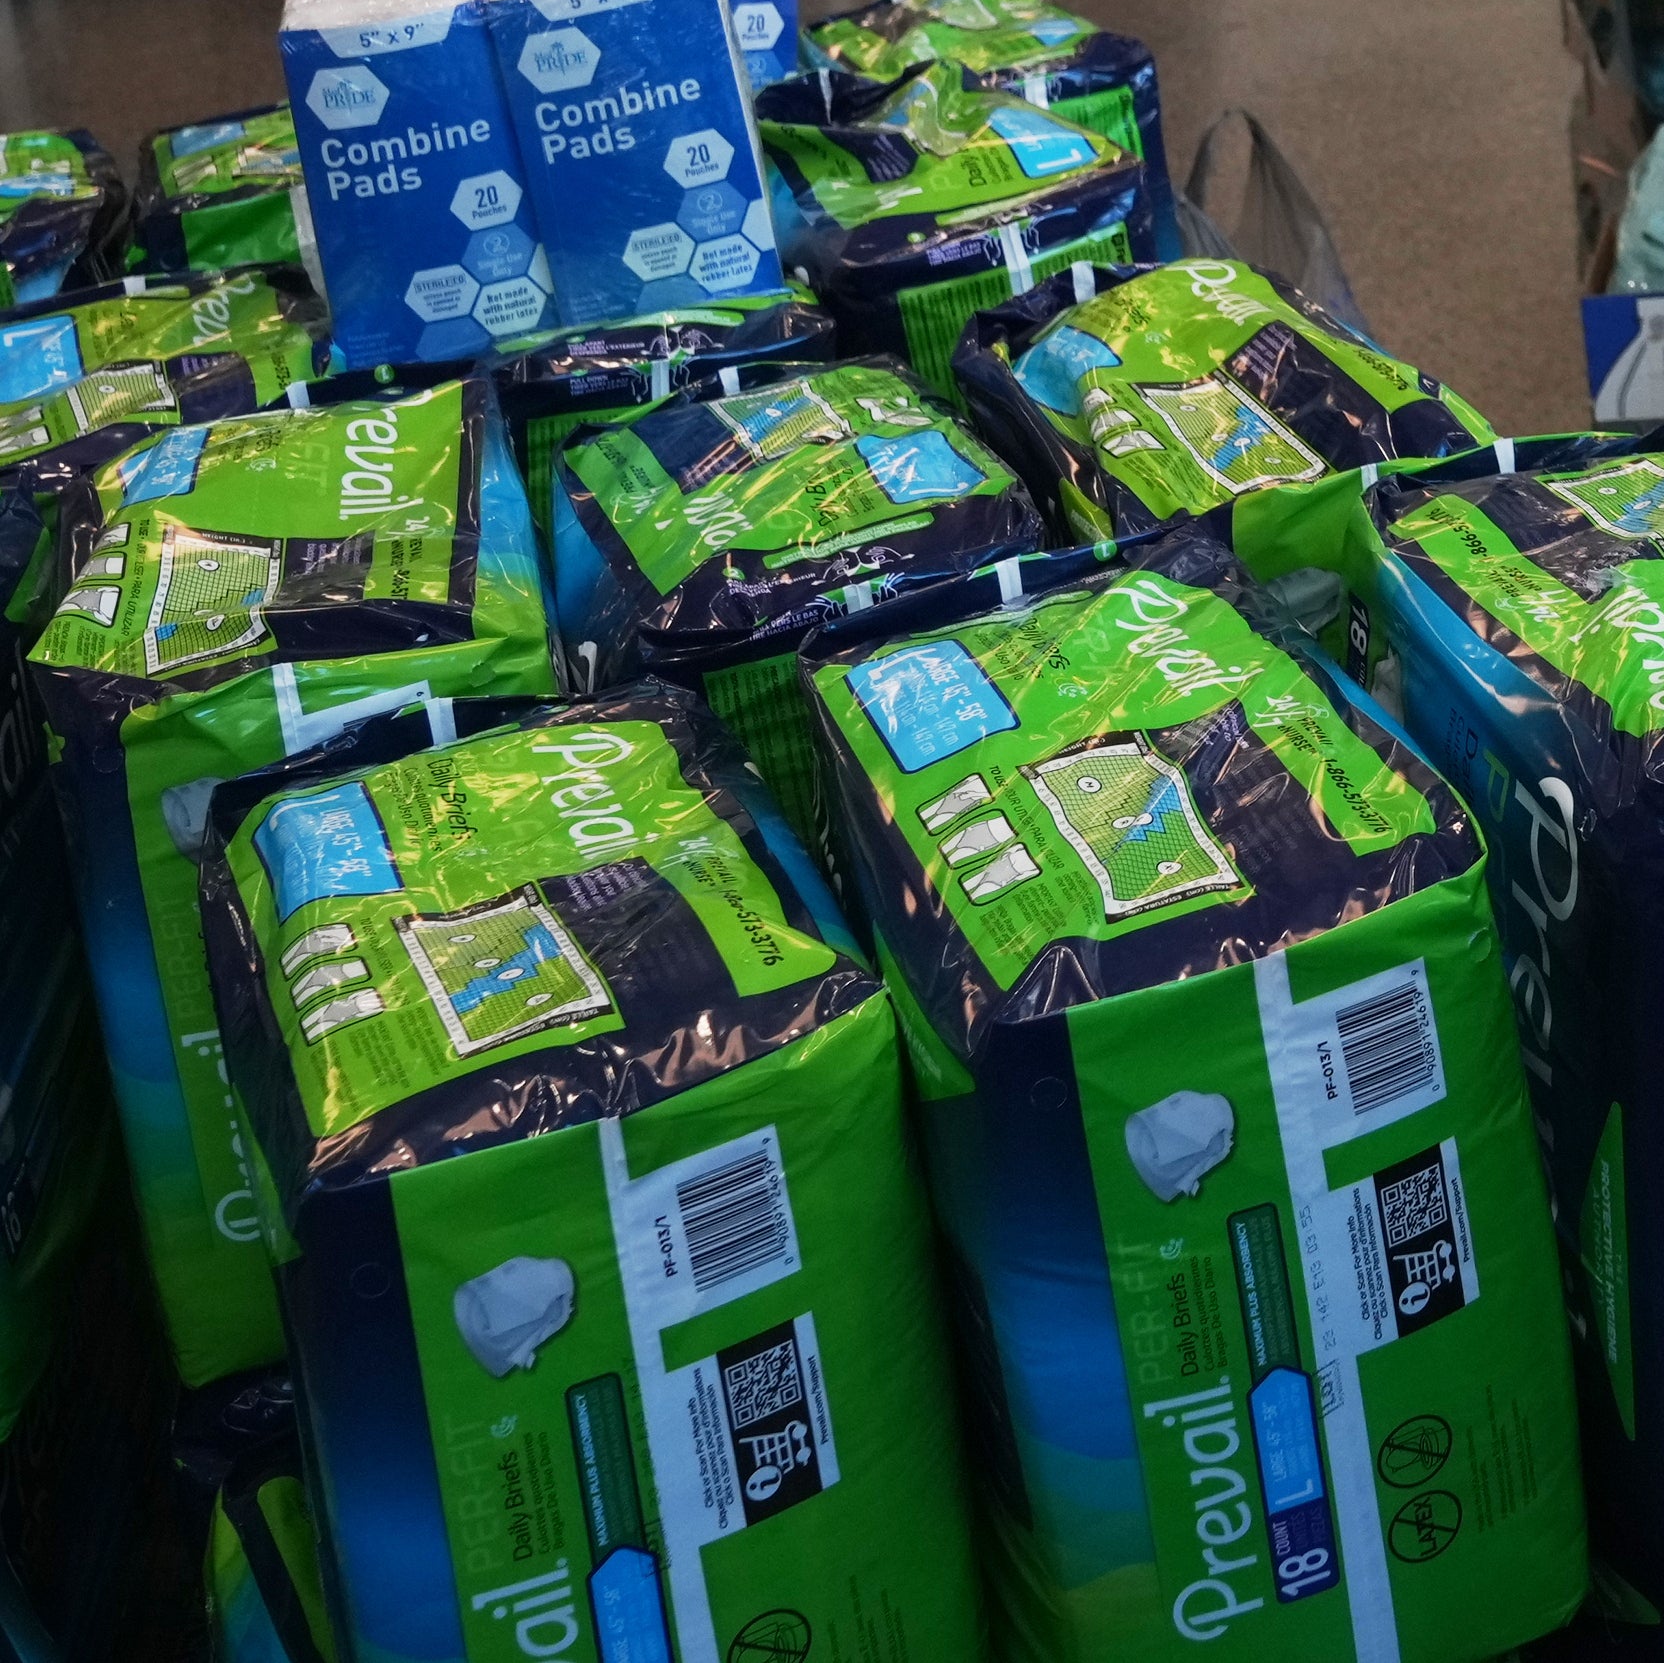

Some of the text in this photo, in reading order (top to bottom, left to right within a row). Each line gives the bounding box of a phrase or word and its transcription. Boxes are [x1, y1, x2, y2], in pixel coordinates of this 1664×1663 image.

[359, 23, 424, 47] 5" x 9"
[747, 14, 765, 33] 20
[535, 78, 701, 132] Combine
[321, 119, 491, 168] Combine
[542, 124, 636, 165] Pads
[687, 144, 710, 167] 20
[327, 164, 422, 201] Pads
[475, 185, 498, 208] 20
[1350, 604, 1367, 656] 18
[956, 704, 987, 722] 58"
[1414, 991, 1429, 1027] 24619
[1418, 1033, 1433, 1072] 90891
[1317, 1041, 1337, 1100] PF-013/1
[1345, 1215, 1356, 1232] Info
[1349, 1187, 1368, 1245] d'informations
[1362, 1203, 1378, 1251] Información
[1449, 1177, 1471, 1262] Prevail.com/Support
[1601, 1160, 1613, 1280] PROTECTIVE
[655, 1214, 677, 1277] PF-013/1
[1348, 1232, 1360, 1253] More
[1361, 1246, 1371, 1266] pour
[1352, 1254, 1362, 1269] For
[1370, 1251, 1381, 1270] Para
[1233, 1221, 1268, 1366] MAXIMUM PLUS ABSORBENCY
[1355, 1269, 1366, 1288] Scan
[1364, 1266, 1376, 1298] scannez
[1373, 1270, 1384, 1291] Scan
[1206, 1290, 1219, 1312] Uso
[1360, 1299, 1371, 1320] Click
[1378, 1300, 1389, 1318] Click
[1164, 1272, 1204, 1376] Daily Briefs
[1209, 1313, 1221, 1328] De
[1370, 1309, 1384, 1339] Cliquez
[808, 1355, 828, 1444] Prevail.com/Support
[498, 1450, 532, 1562] Daily Briefs
[1275, 1479, 1314, 1505] L
[1415, 1496, 1437, 1556] LATEX
[1274, 1521, 1331, 1596] 18 COUNT
